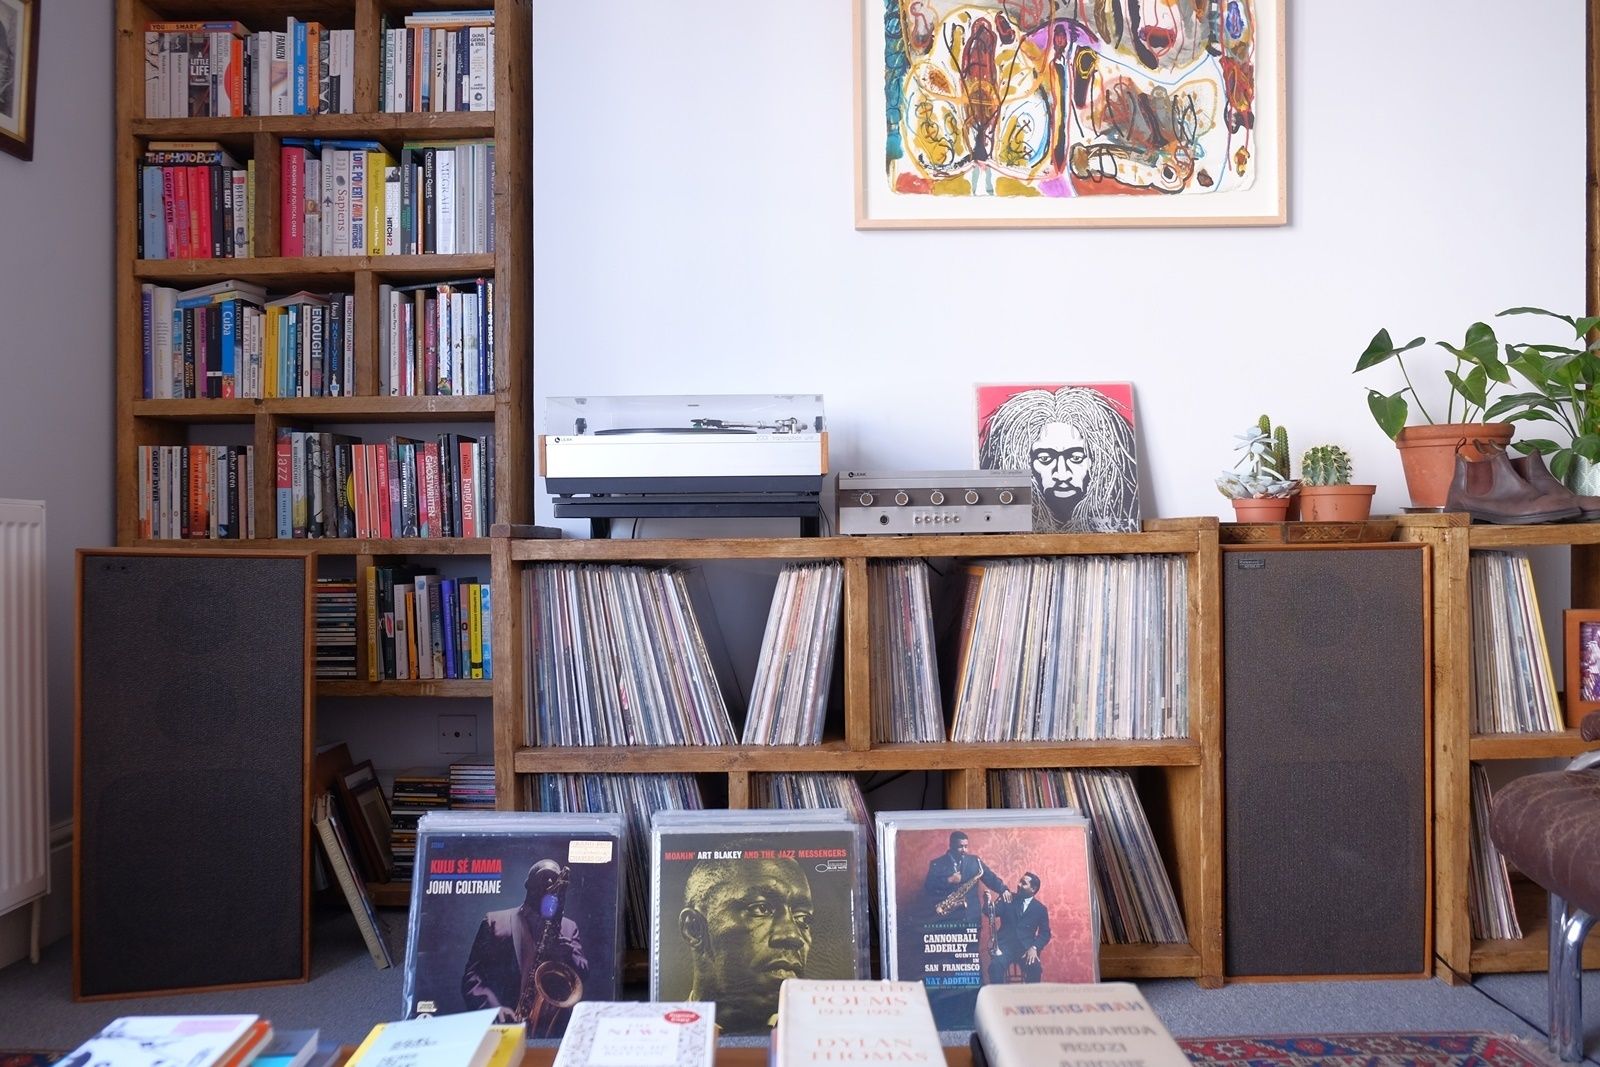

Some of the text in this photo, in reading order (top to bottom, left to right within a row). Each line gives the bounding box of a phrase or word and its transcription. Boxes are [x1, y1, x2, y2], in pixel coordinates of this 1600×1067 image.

[276, 35, 285, 60] FRANZEN
[190, 66, 209, 75] LIFE
[235, 185, 244, 212] BIRDS
[335, 189, 347, 231] Sapiens
[223, 311, 232, 335] Cuba
[312, 308, 321, 357] ENOUGH
[278, 451, 291, 481] Jazz
[425, 456, 435, 517] GHOSTWRITTEN
[463, 478, 472, 520] Funny Girl
[714, 851, 742, 859] BLAKEY
[744, 851, 759, 859] AND
[761, 851, 774, 859] THE
[799, 849, 847, 858] MESSENGERS
[430, 859, 454, 873] KULU
[472, 859, 502, 873] MAMA
[426, 880, 501, 894] JOHN COLTRANE
[924, 934, 978, 943] CANNONBALL
[925, 944, 968, 953] ADDERLEY
[812, 995, 907, 1006] POEMS
[1002, 1002, 1144, 1016] AMERICANAH
[1012, 1025, 1156, 1036] CHIMAMANDA
[817, 1038, 912, 1047] DYLAN
[1061, 1042, 1128, 1053] NGOZI
[812, 1052, 928, 1061] THOMAS
